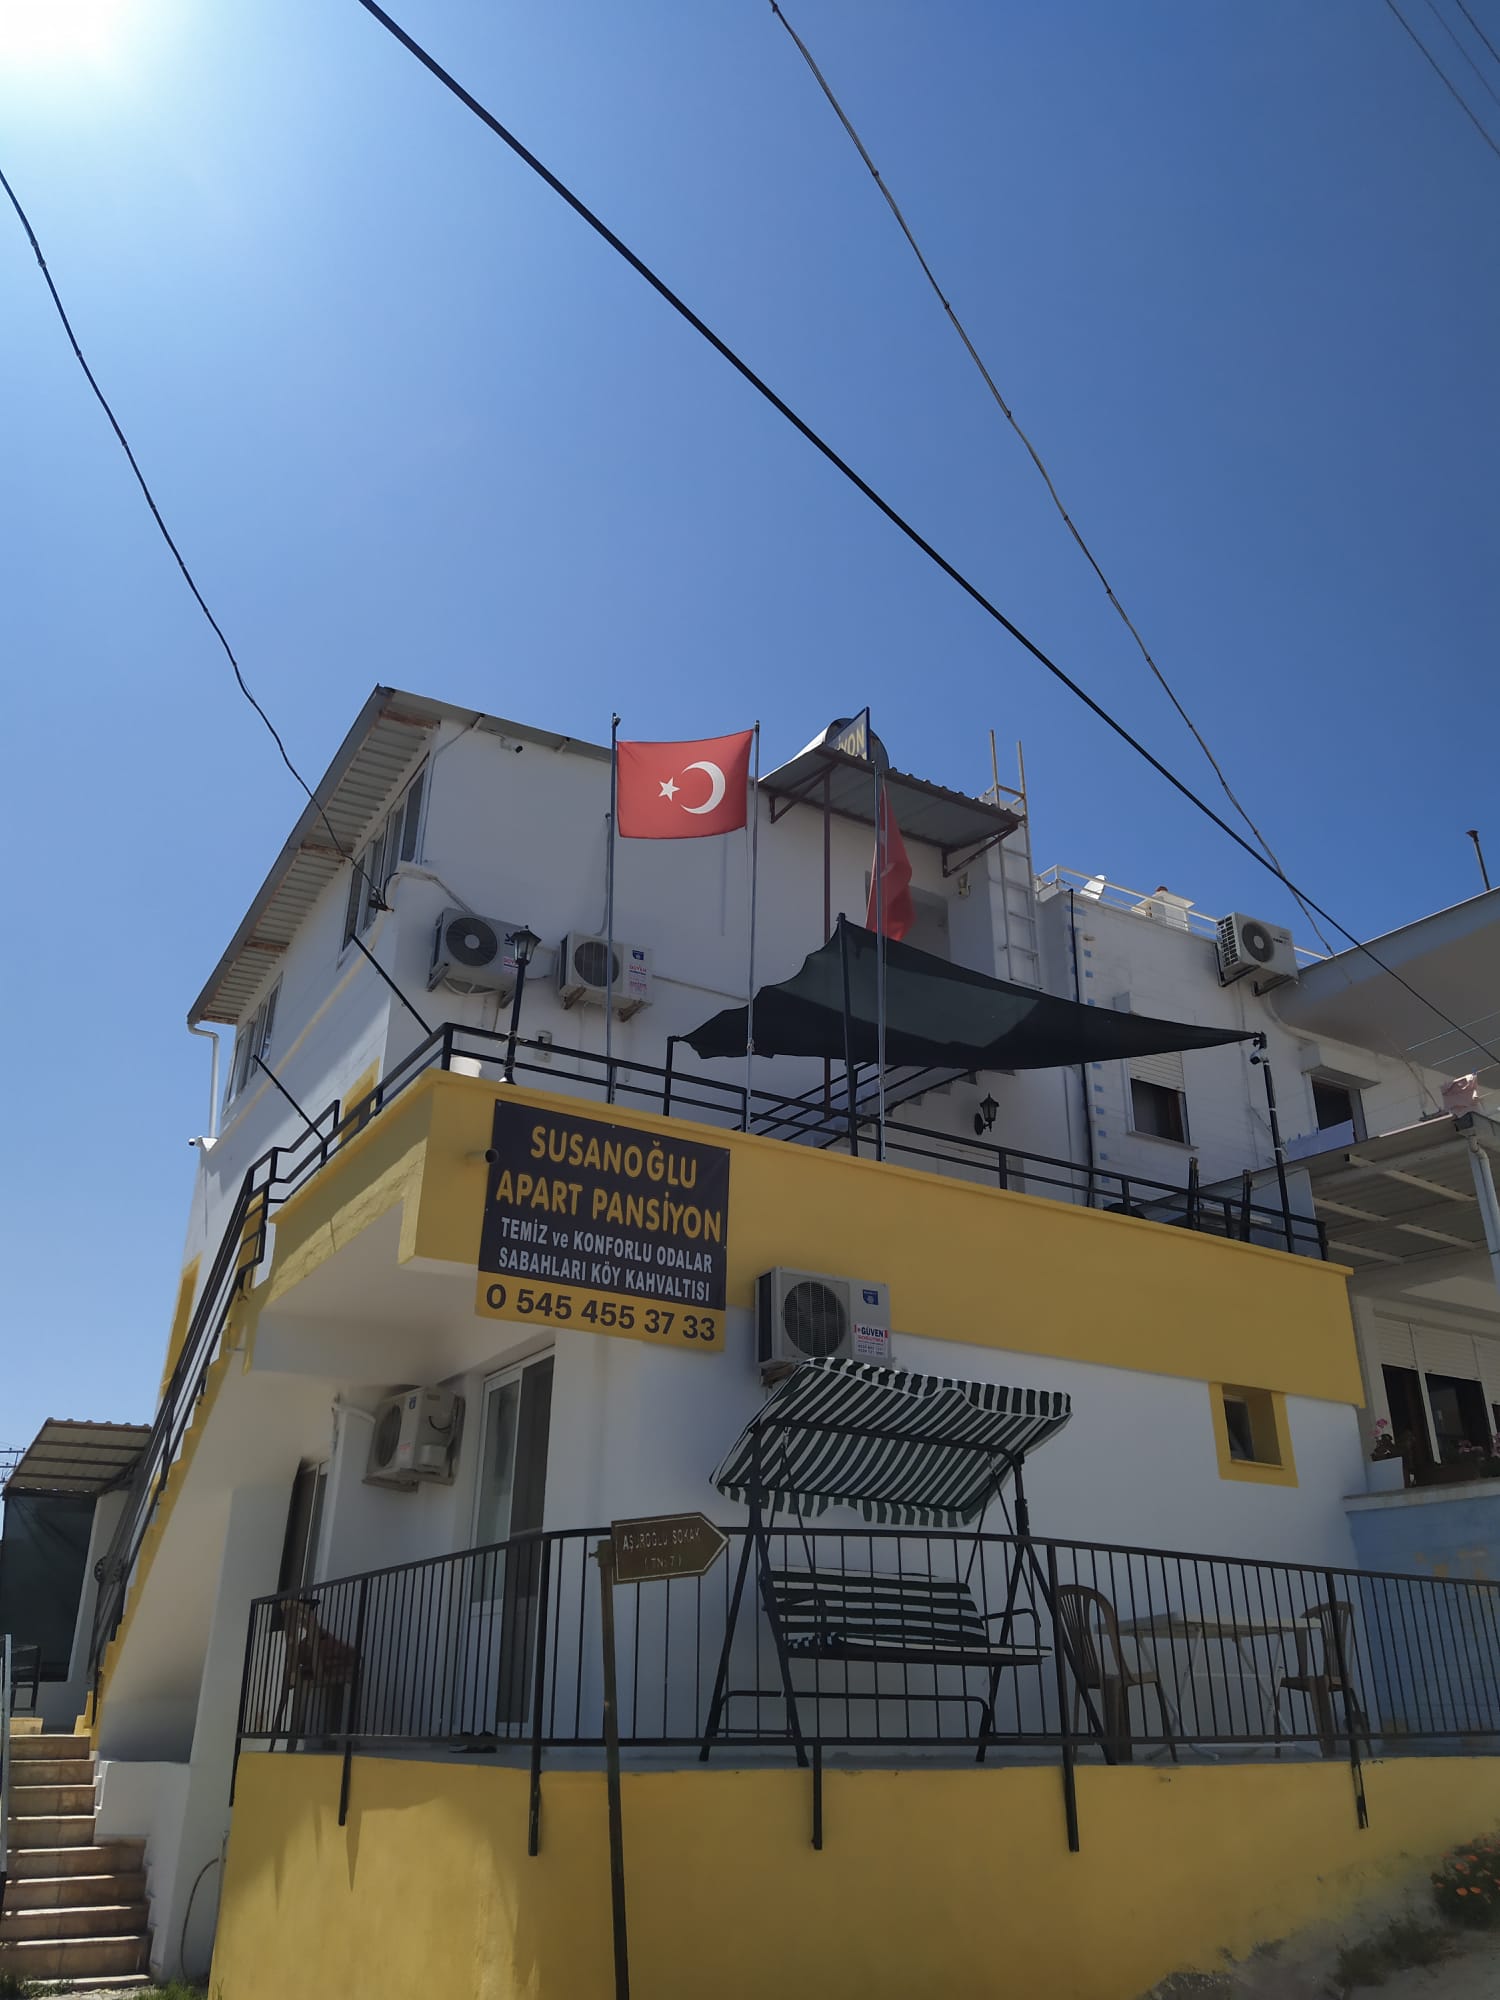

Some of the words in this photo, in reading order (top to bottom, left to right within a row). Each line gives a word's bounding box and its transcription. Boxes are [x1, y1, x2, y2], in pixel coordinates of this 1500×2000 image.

[530, 1125, 697, 1189] SUSANOĞLU
[496, 1169, 583, 1216] APART
[592, 1188, 721, 1243] PANSİYON
[498, 1246, 586, 1281] SABAHLARI
[591, 1261, 621, 1286] KÖY
[625, 1268, 710, 1302] KAHVALTISI
[501, 1216, 548, 1245] TEMİZ
[552, 1231, 569, 1249] ve
[573, 1230, 652, 1263] KONFORLU
[656, 1246, 713, 1274] ODALAR
[516, 1288, 573, 1320] 545
[581, 1300, 635, 1330] 455
[644, 1309, 675, 1336] 37
[682, 1314, 716, 1342] 33
